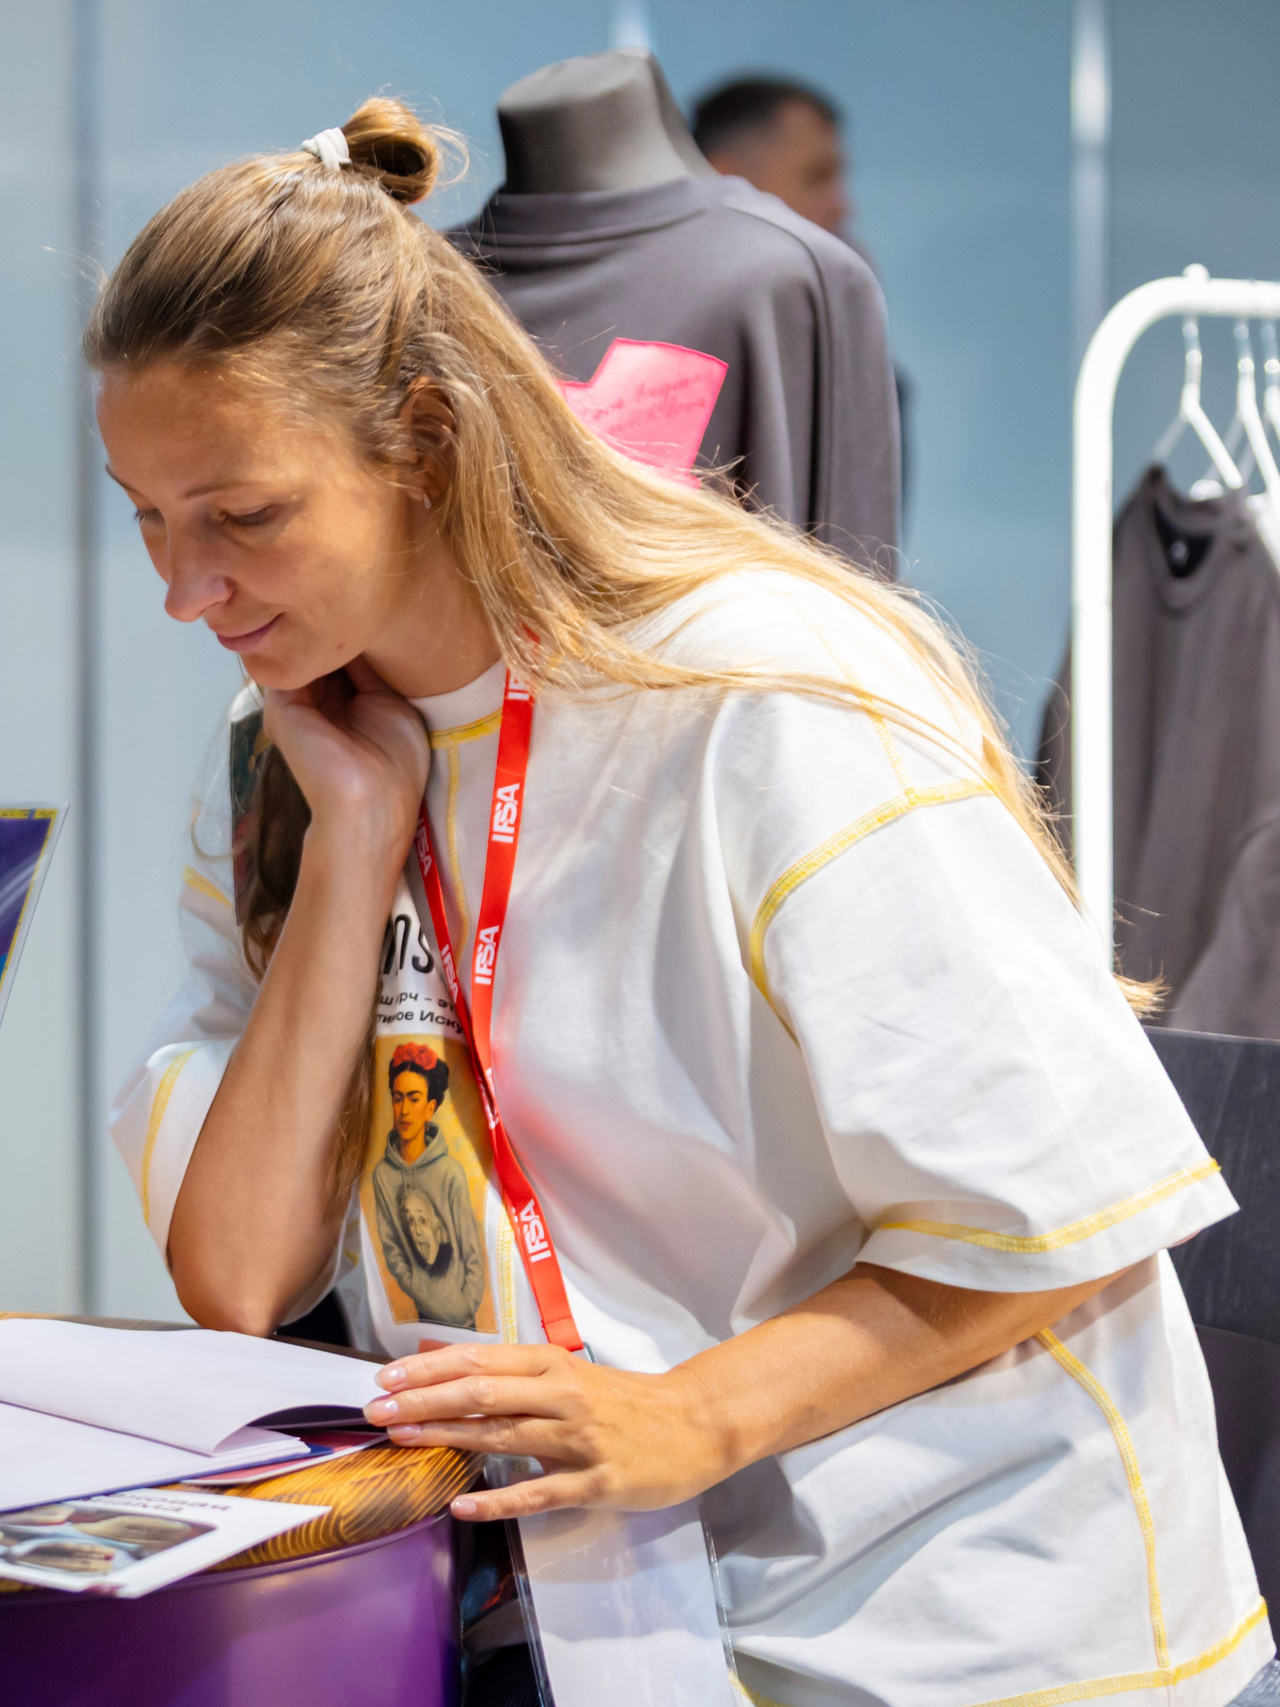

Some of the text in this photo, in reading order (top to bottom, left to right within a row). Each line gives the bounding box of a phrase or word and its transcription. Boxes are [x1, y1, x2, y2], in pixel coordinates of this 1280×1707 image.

[491, 783, 520, 843] IFSA
[475, 925, 500, 985] IFSA
[520, 1199, 551, 1263] IFSA
